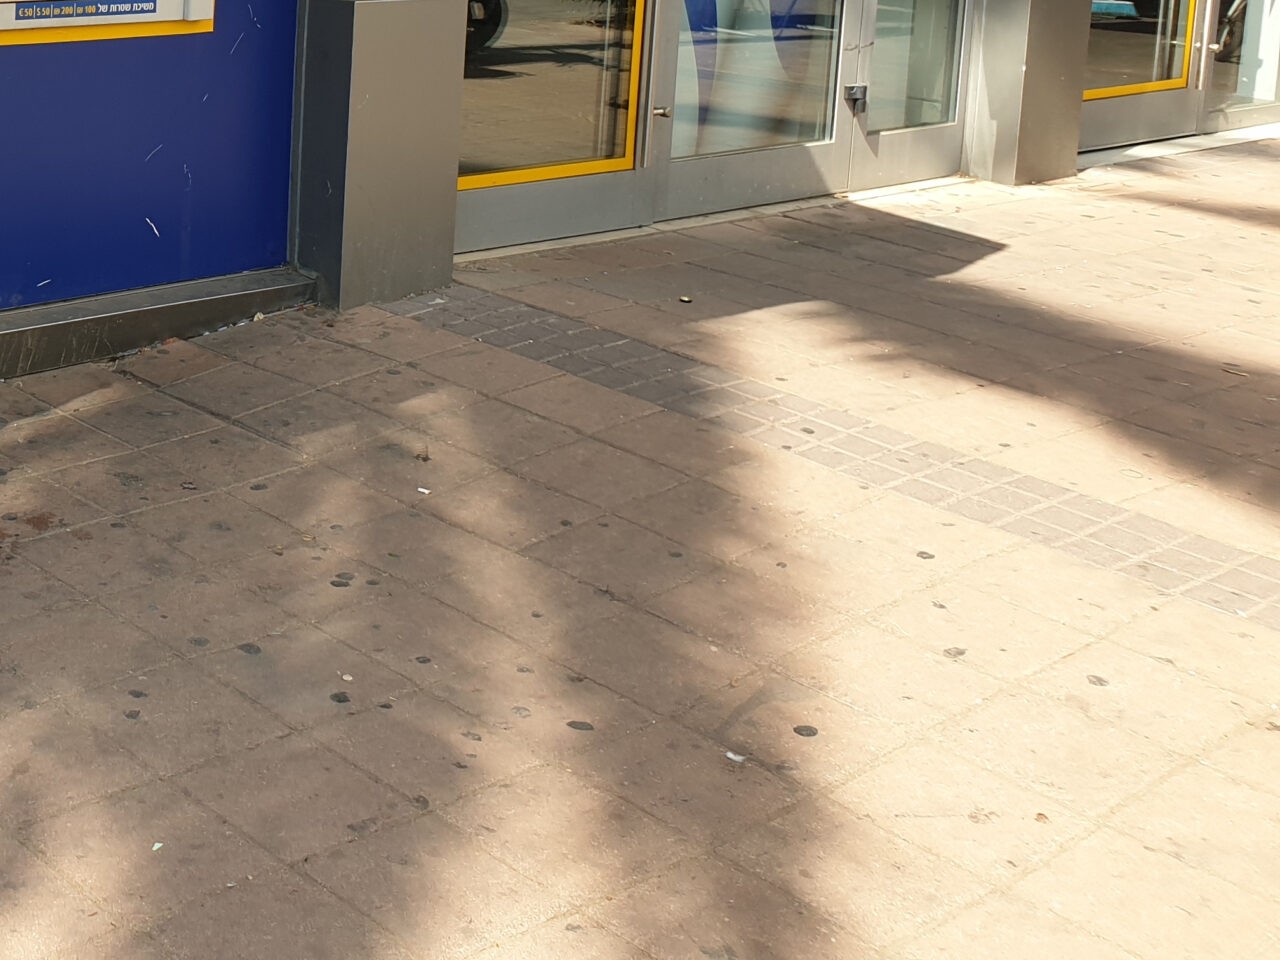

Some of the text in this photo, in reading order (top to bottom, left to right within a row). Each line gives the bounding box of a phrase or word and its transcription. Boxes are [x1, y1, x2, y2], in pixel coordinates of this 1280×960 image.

[61, 6, 73, 15] 200
[85, 5, 96, 14] 100
[98, 4, 108, 13] של
[132, 2, 154, 11] משיכת
